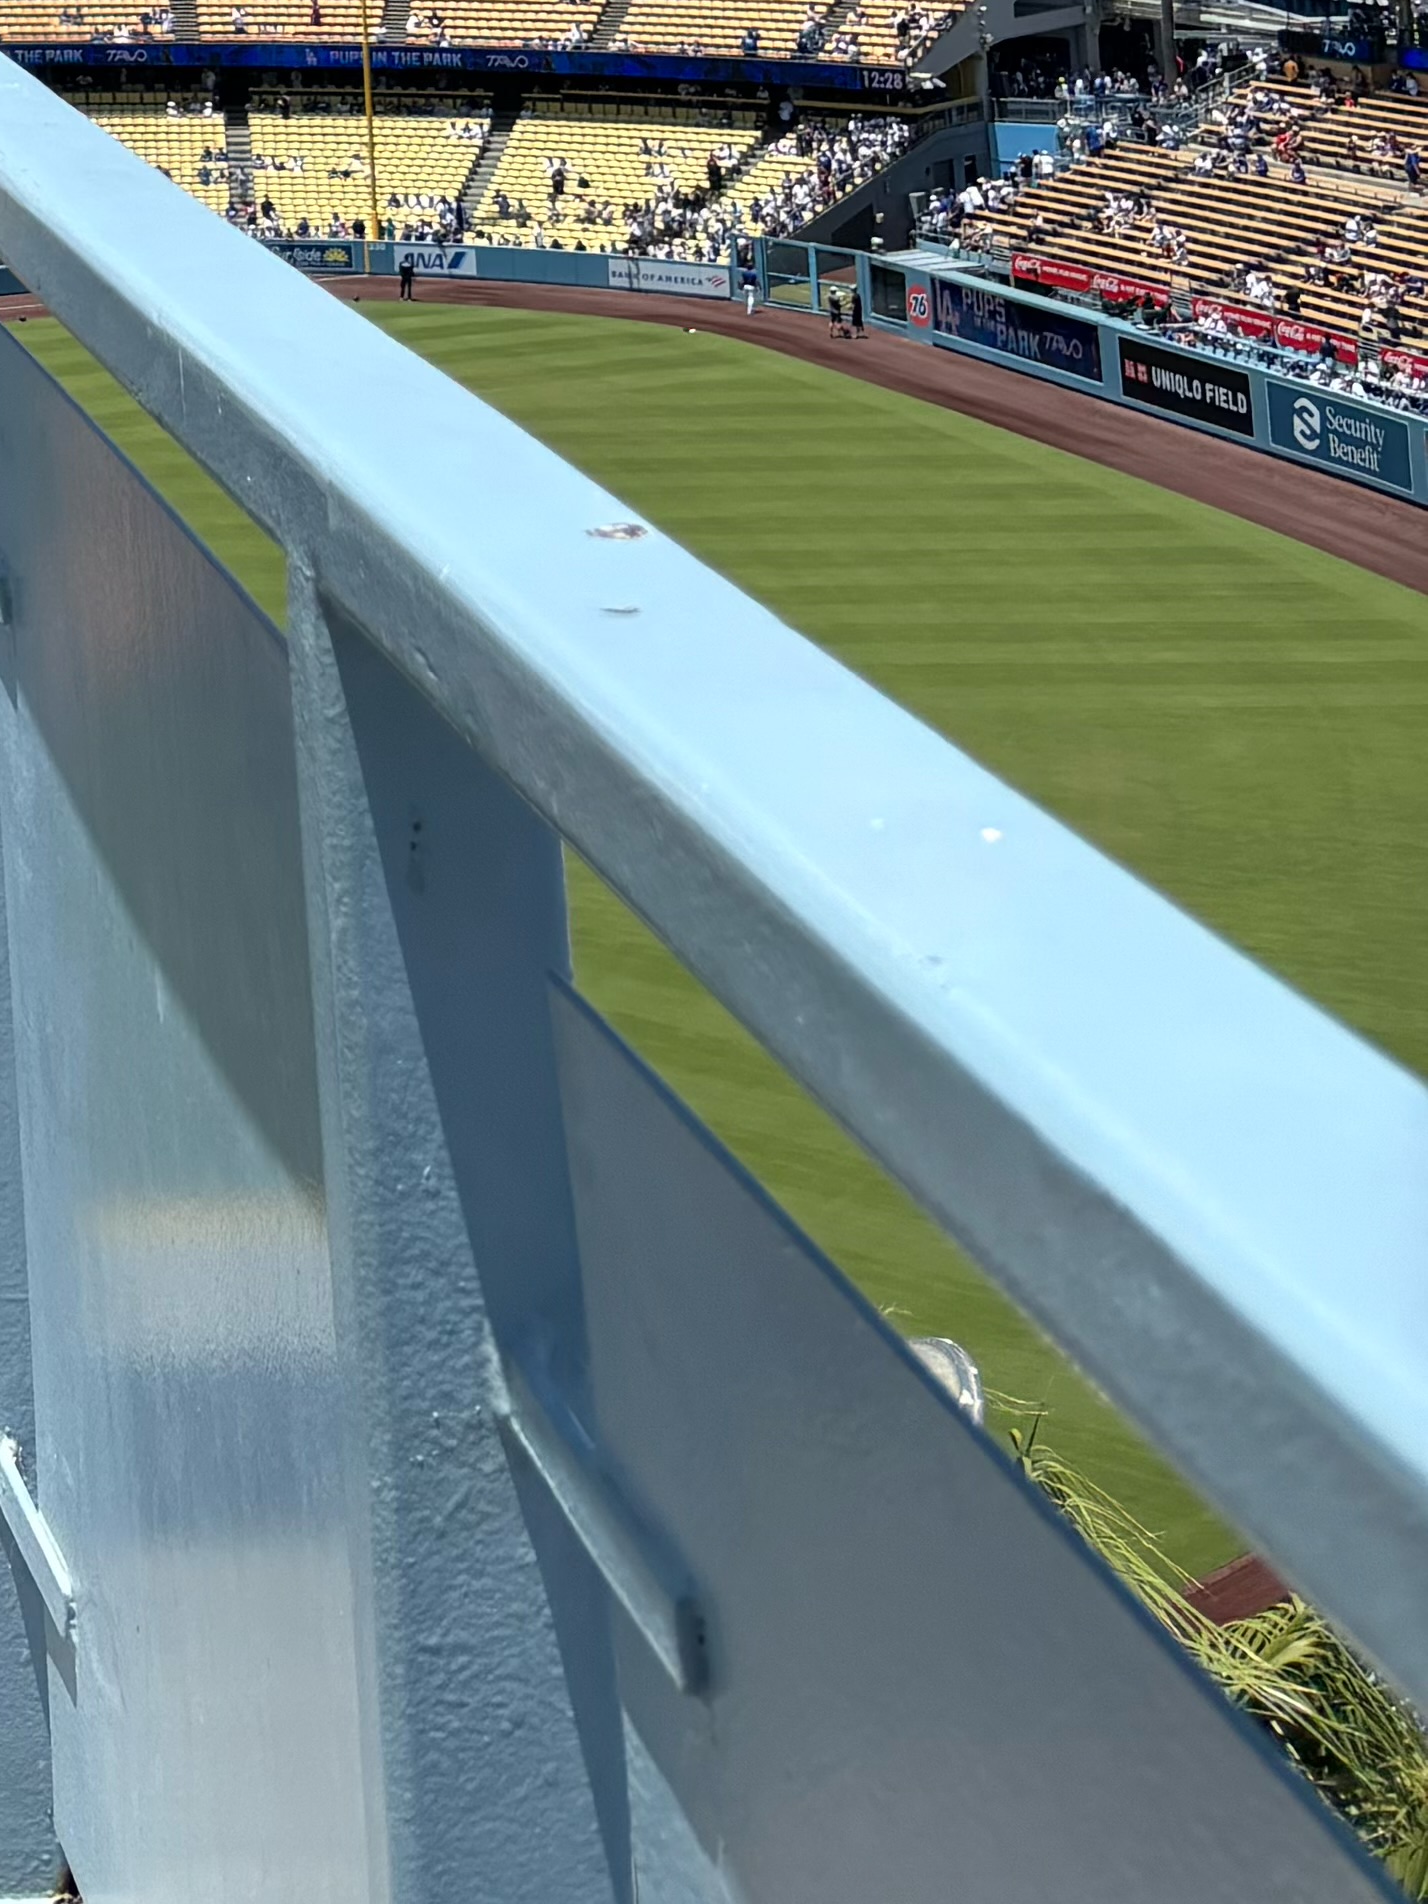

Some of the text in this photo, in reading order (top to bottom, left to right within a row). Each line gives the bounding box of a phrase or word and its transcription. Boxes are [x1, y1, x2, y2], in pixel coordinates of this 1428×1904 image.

[14, 49, 83, 64] THE PARK
[372, 51, 387, 65] IN
[391, 52, 421, 65] THE
[423, 52, 462, 67] PARK
[486, 55, 529, 68] TAVO
[862, 70, 903, 89] 12:28
[642, 273, 655, 281] OF
[657, 275, 703, 286] AMERICA
[909, 293, 928, 318] 76
[961, 287, 1006, 322] PUPS
[996, 324, 1041, 358] PARK
[1151, 366, 1202, 400] UNIQLO
[1205, 380, 1248, 414] FIELD
[1326, 406, 1385, 450] Security
[1328, 434, 1380, 472] Benefit
